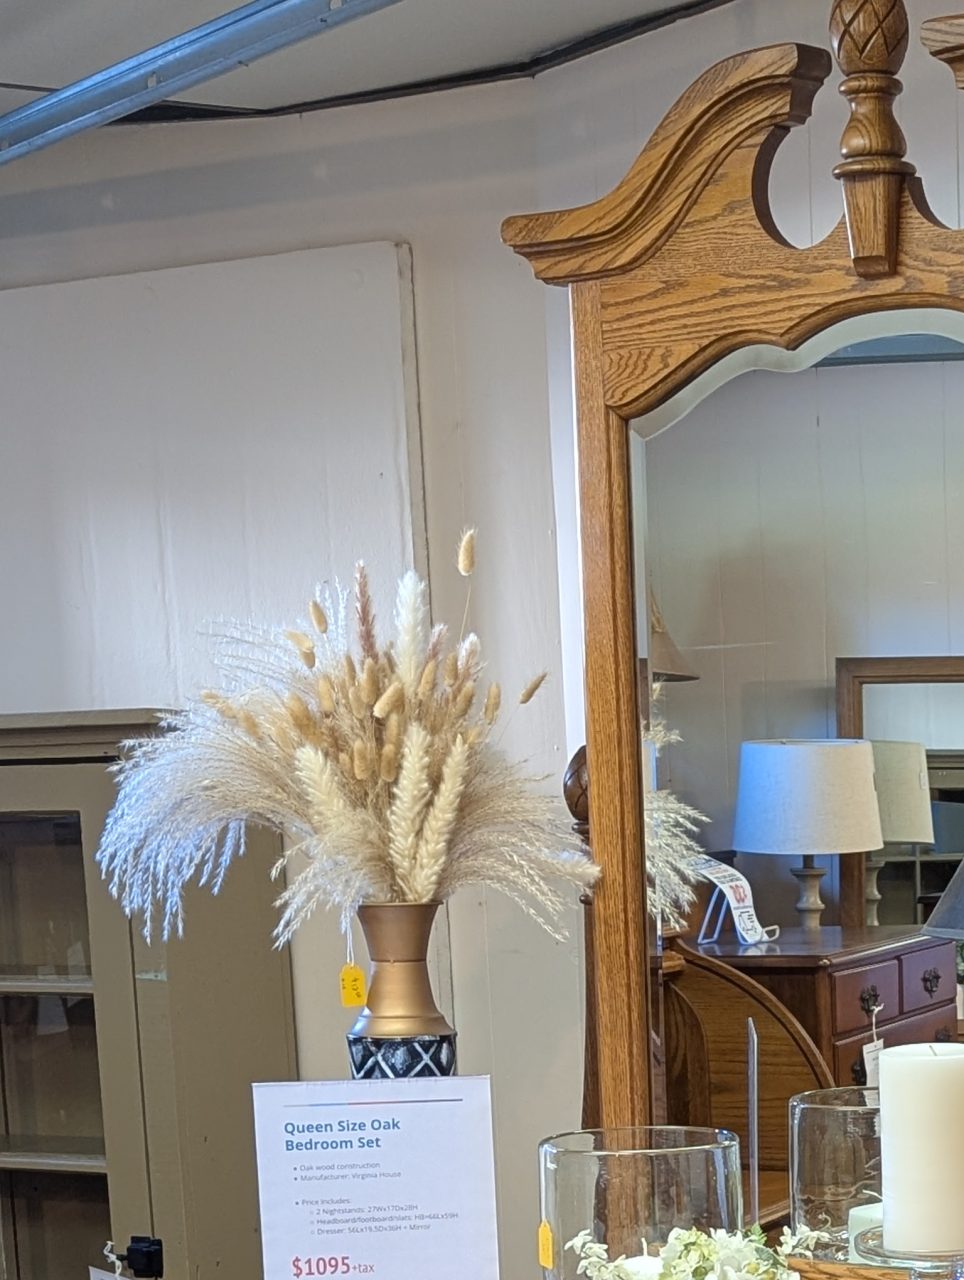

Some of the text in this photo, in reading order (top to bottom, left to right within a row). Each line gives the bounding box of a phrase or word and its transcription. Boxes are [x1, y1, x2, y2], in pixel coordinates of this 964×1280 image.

[284, 1118, 401, 1136] Queen Size Oak
[285, 1137, 381, 1151] Bedroom Set
[299, 1162, 381, 1172] Oak wood construction
[351, 1172, 378, 1180] Virginia
